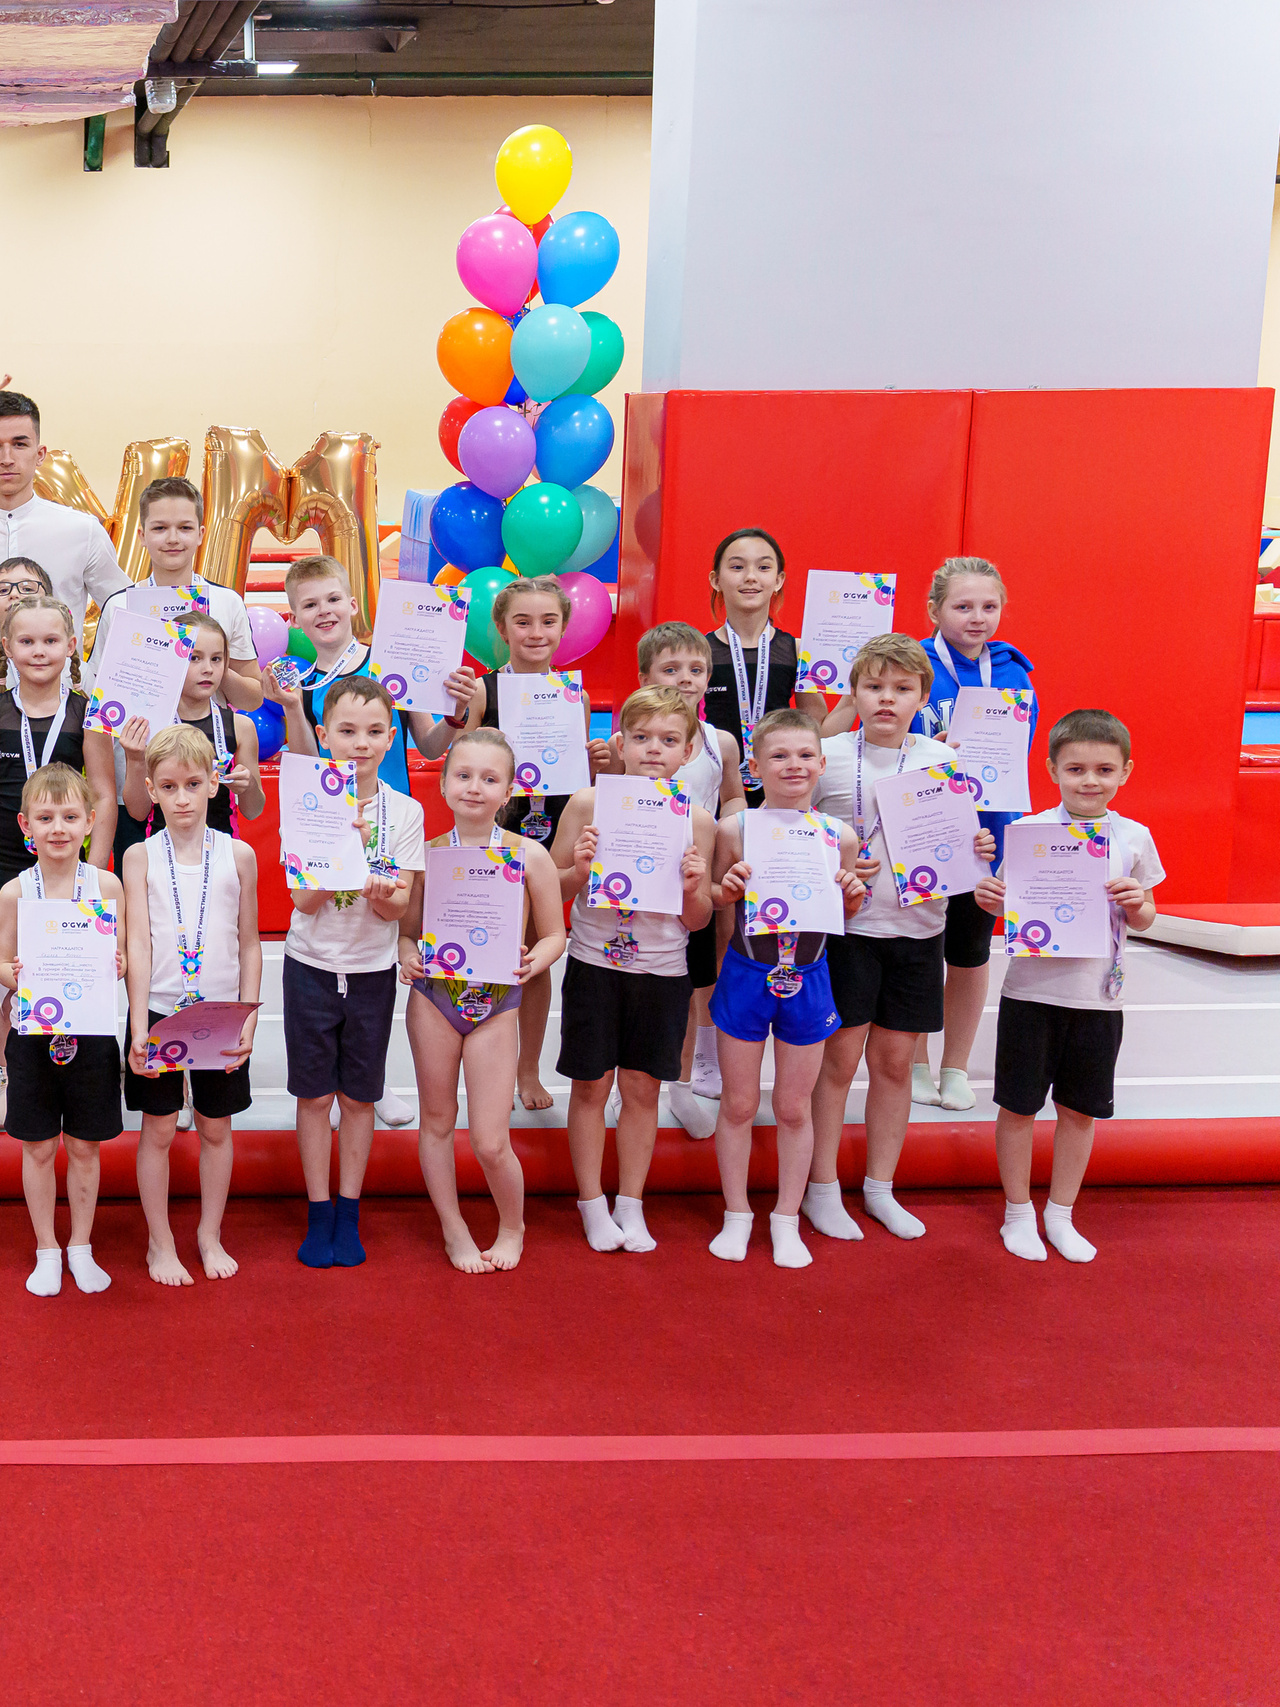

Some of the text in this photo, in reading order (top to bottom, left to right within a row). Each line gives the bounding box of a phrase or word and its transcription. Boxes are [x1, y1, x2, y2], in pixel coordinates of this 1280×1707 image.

[418, 604, 442, 613] O'GYM
[146, 637, 170, 648] O'GYM
[917, 786, 943, 797] O'GYM
[638, 799, 664, 807] O'GYM
[198, 891, 207, 930] гимнастики
